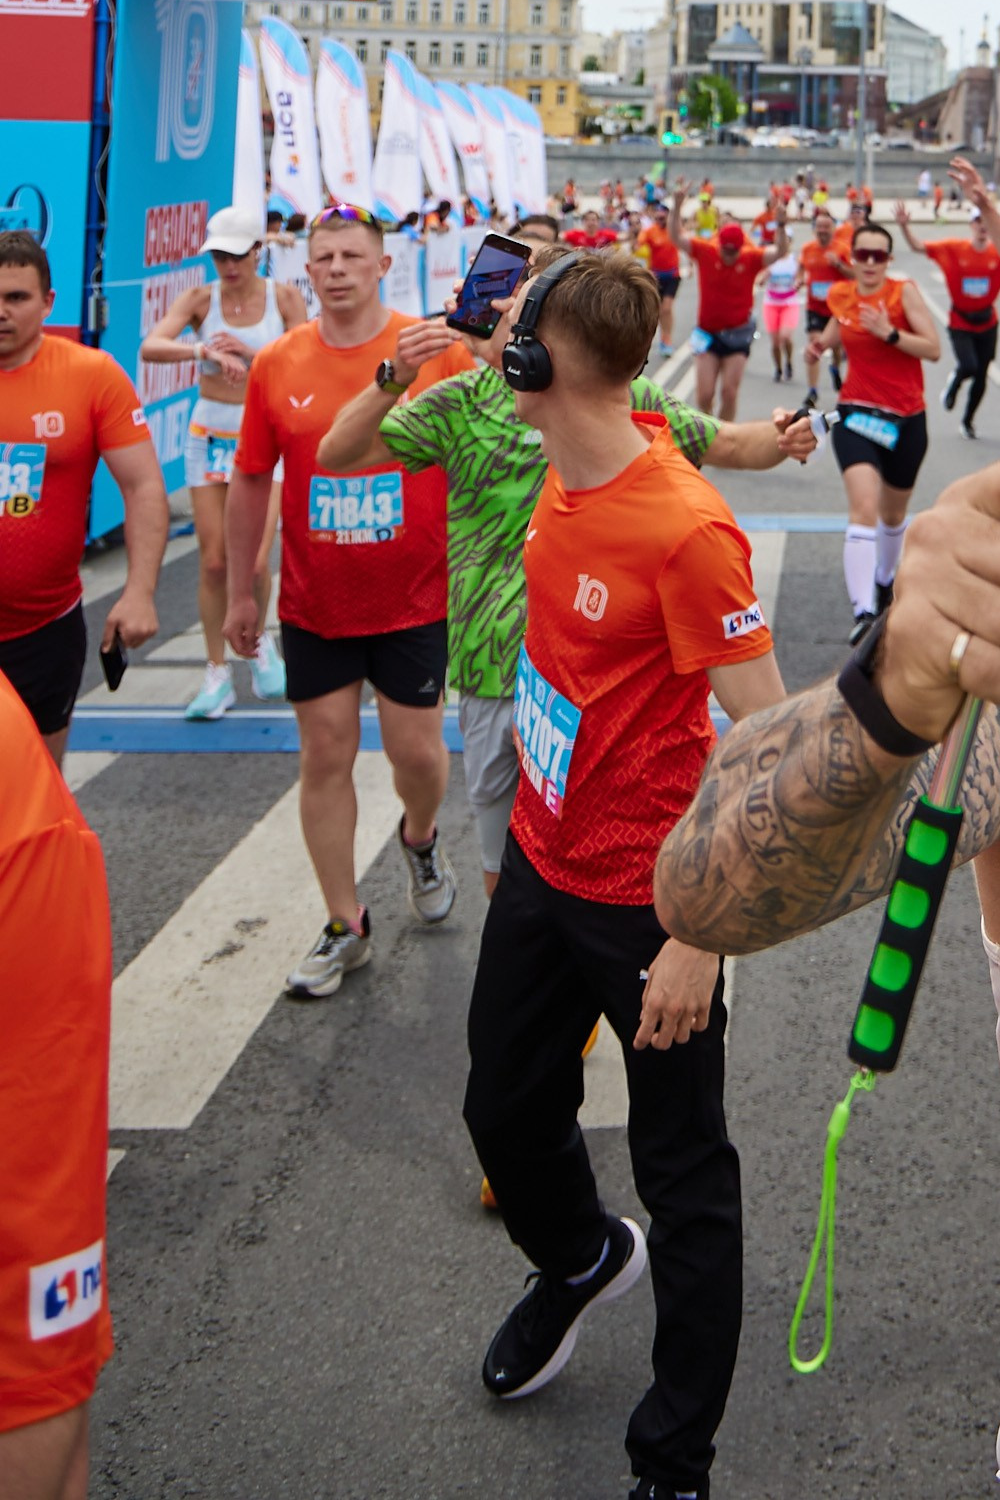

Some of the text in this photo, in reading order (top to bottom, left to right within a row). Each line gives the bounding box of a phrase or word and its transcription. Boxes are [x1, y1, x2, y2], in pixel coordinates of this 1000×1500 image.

[316, 492, 393, 528] 71843
[572, 573, 609, 622] 10
[517, 675, 567, 784] 74707
